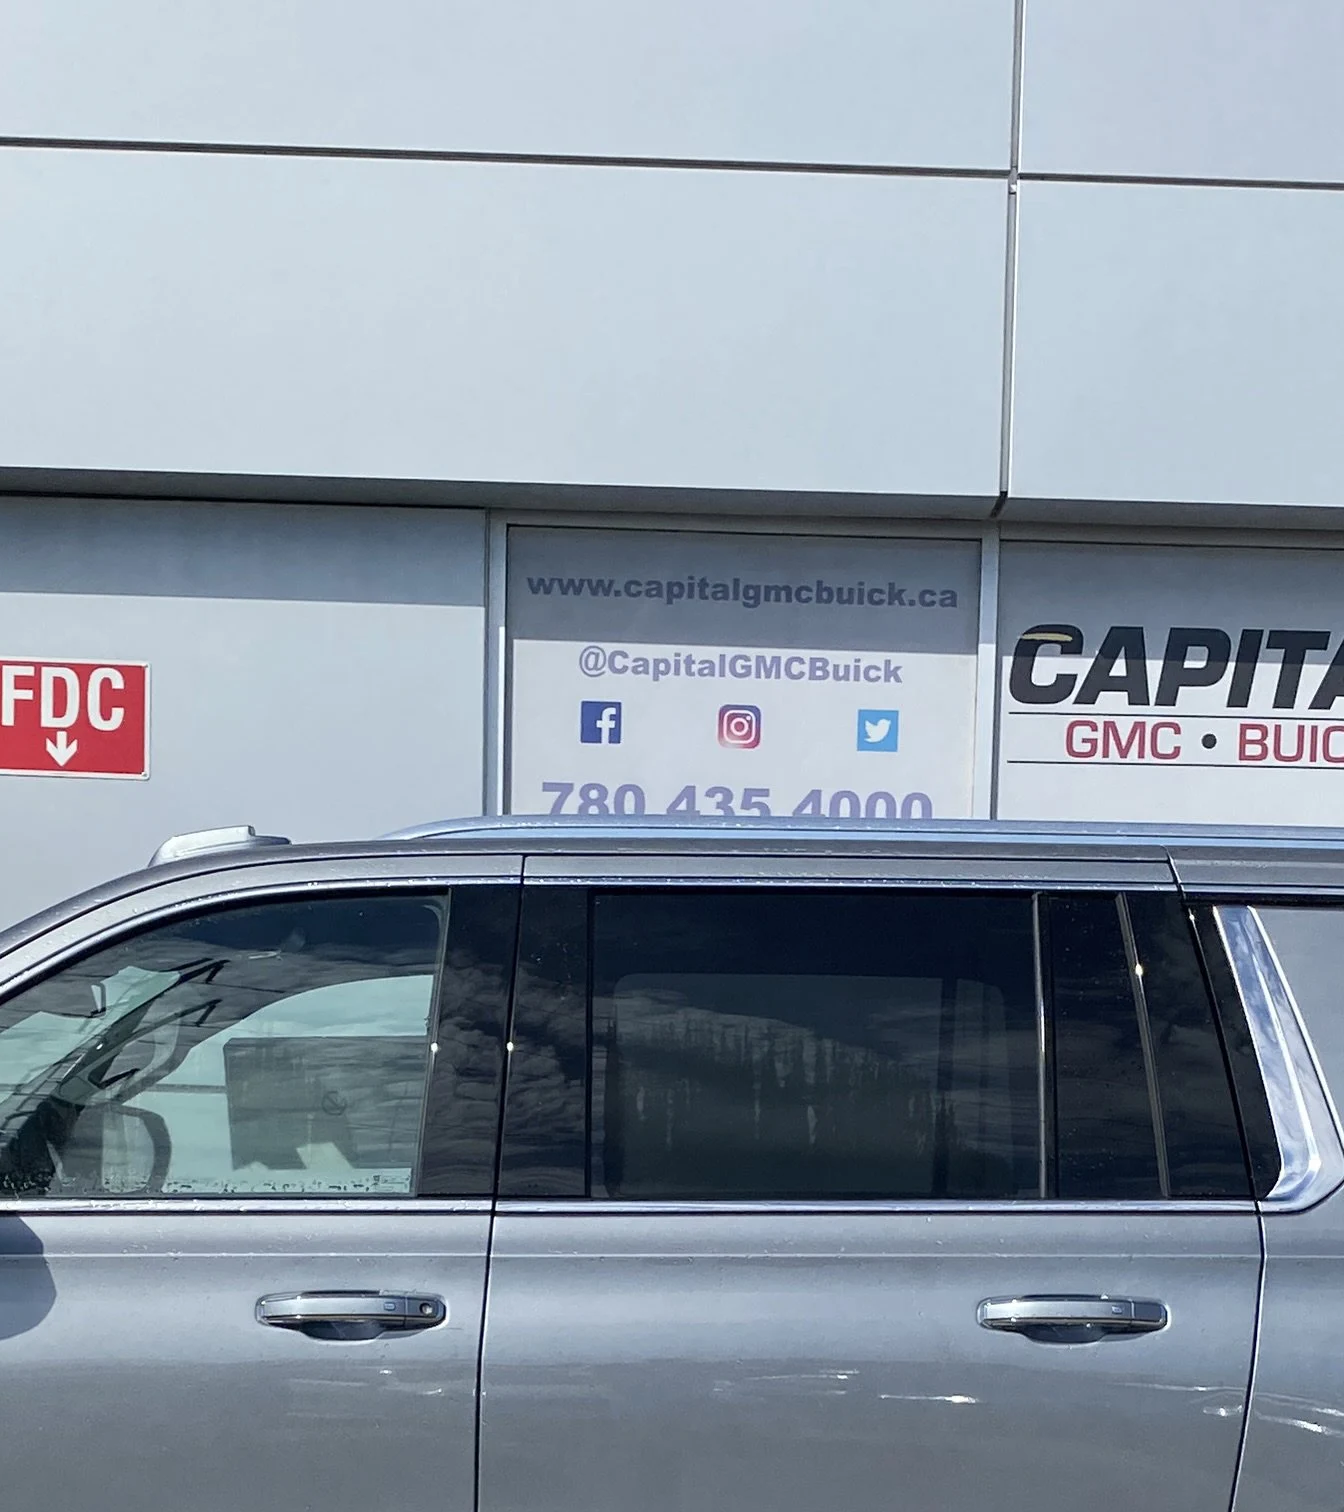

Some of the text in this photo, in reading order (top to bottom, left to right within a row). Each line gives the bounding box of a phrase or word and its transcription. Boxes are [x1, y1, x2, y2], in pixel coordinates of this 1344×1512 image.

[527, 576, 958, 608] www.capitalgmcbuick.ca
[579, 645, 903, 684] @CapitalGMCBuick
[1, 664, 125, 731] FDC
[1065, 720, 1182, 760] GMC
[542, 782, 934, 820] 780 435 4000
